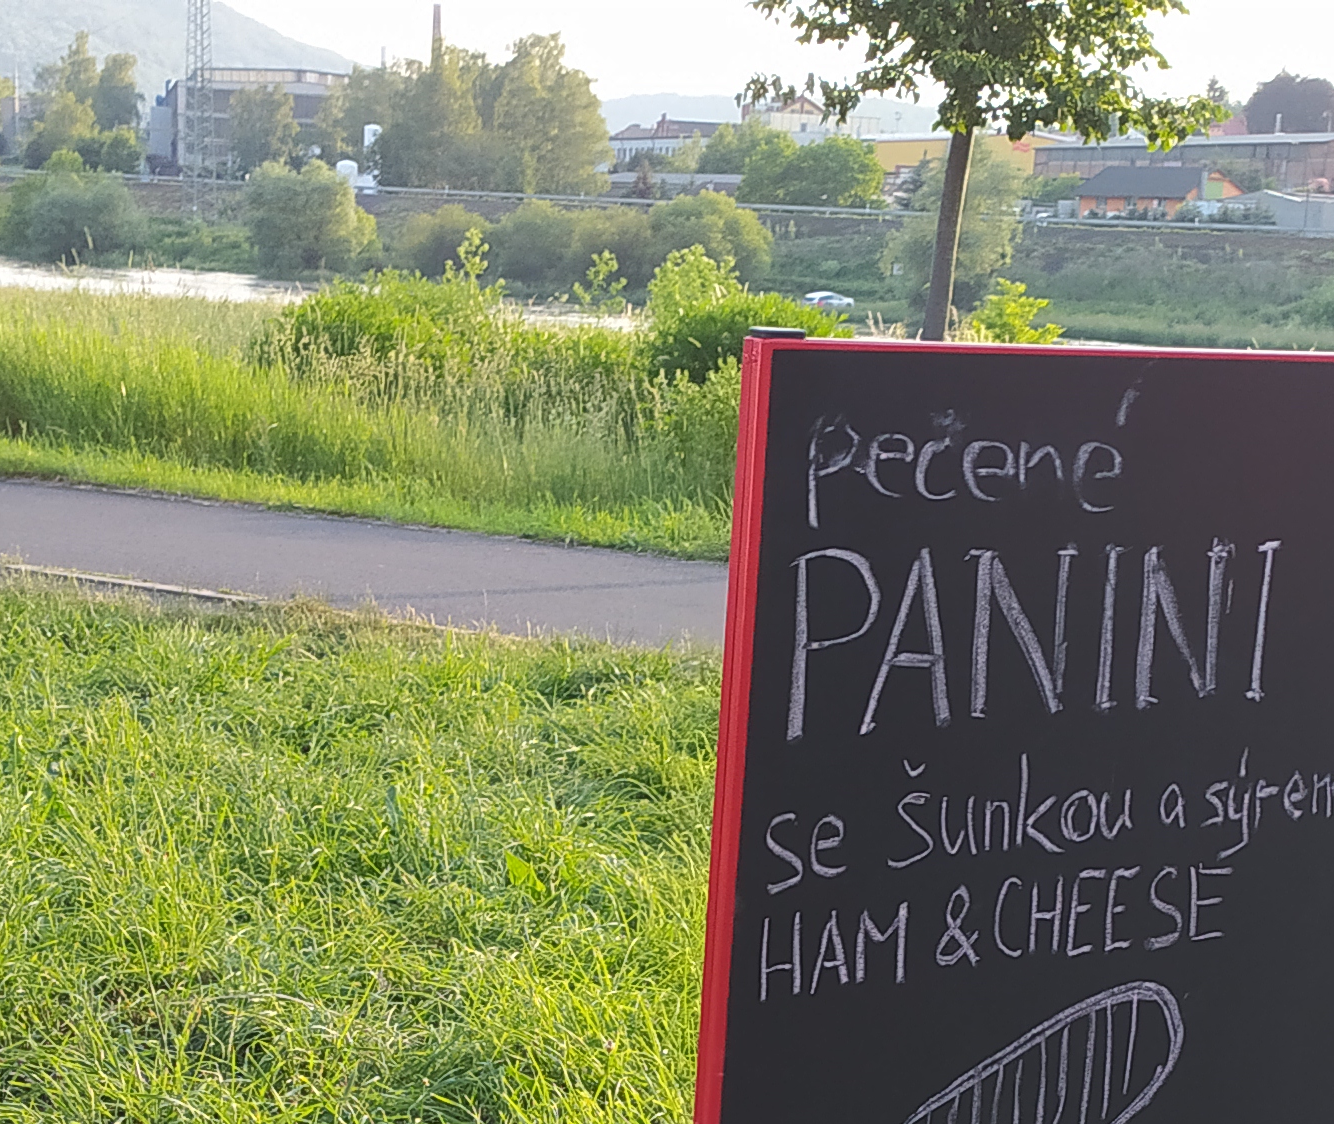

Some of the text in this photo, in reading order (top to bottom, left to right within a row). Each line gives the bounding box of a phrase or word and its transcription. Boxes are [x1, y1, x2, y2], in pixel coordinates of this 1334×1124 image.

[786, 537, 1283, 742] PANINI
[766, 811, 847, 895] se
[887, 753, 1134, 868] šunkou
[1158, 782, 1188, 832] a
[759, 861, 1234, 1003] HAM & CHEESE
